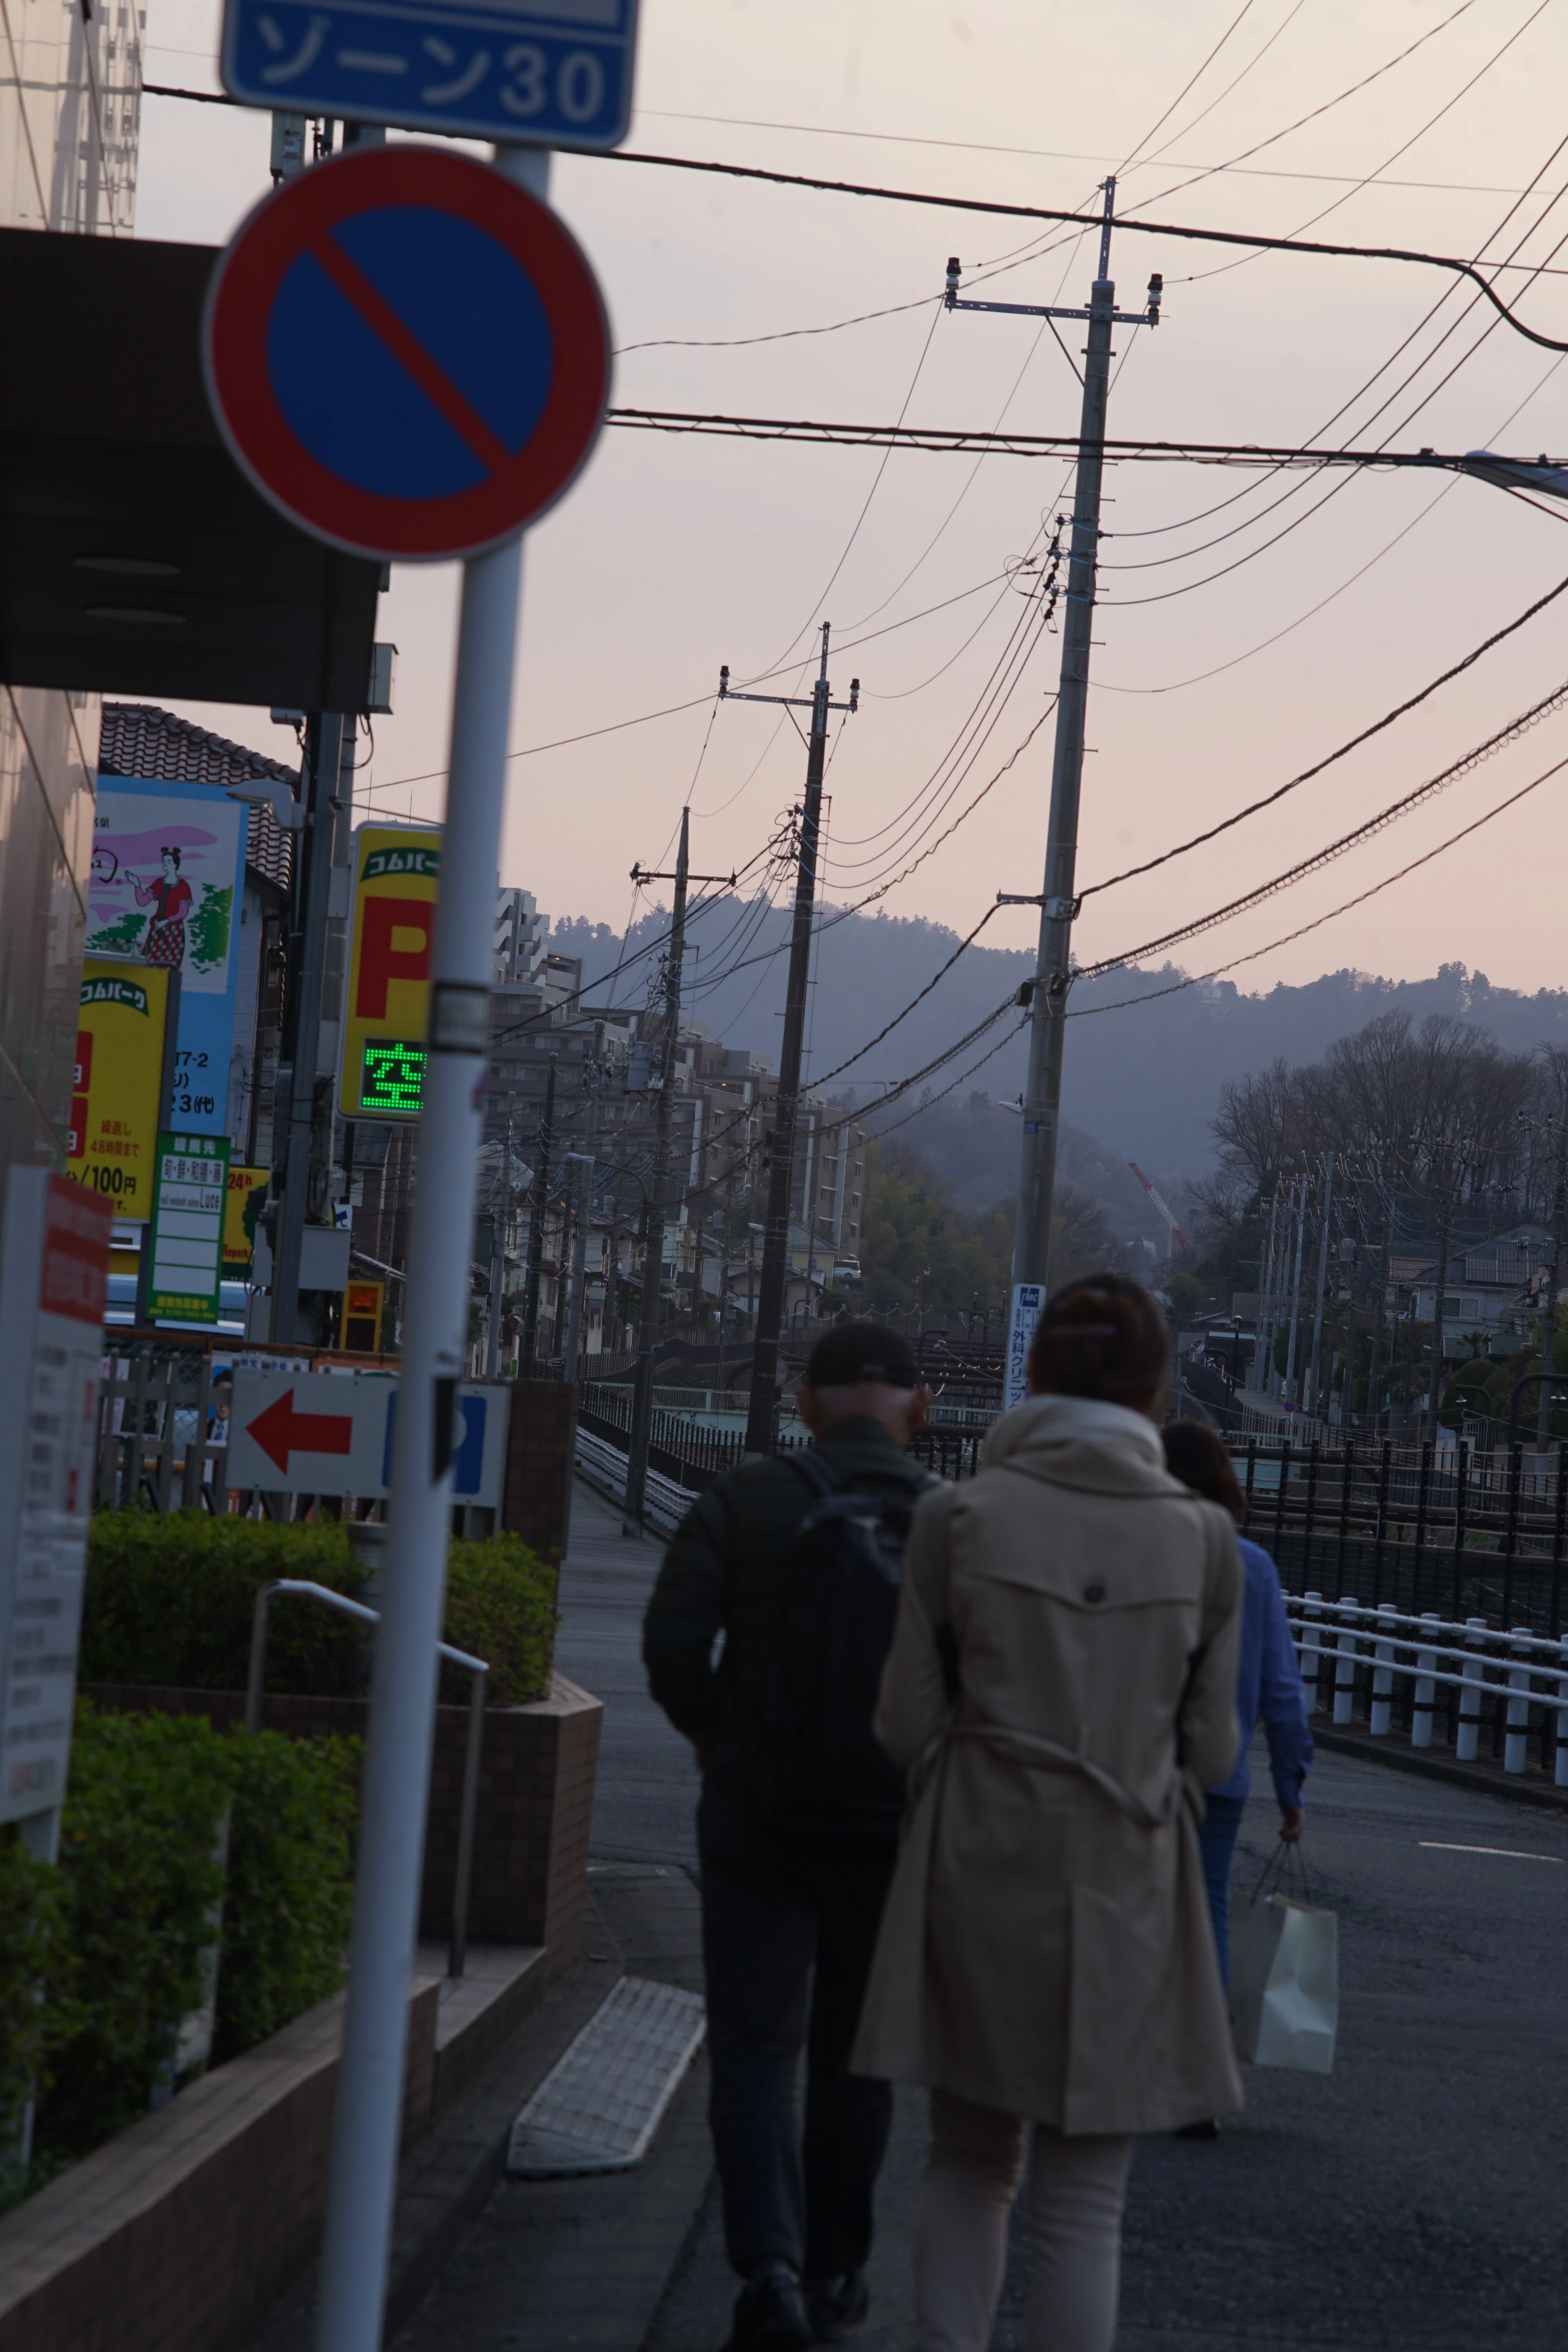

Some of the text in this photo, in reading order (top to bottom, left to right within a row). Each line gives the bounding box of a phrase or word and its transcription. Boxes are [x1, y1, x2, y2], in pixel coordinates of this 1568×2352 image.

[81, 982, 145, 1009] コムパーク
[362, 1042, 426, 1109] 空
[101, 1119, 132, 1136] 繰返し
[91, 1139, 139, 1157] 48時間まで
[200, 1188, 220, 1210] Luce
[223, 1245, 248, 1258] Repark
[1020, 1293, 1038, 1304] TMC
